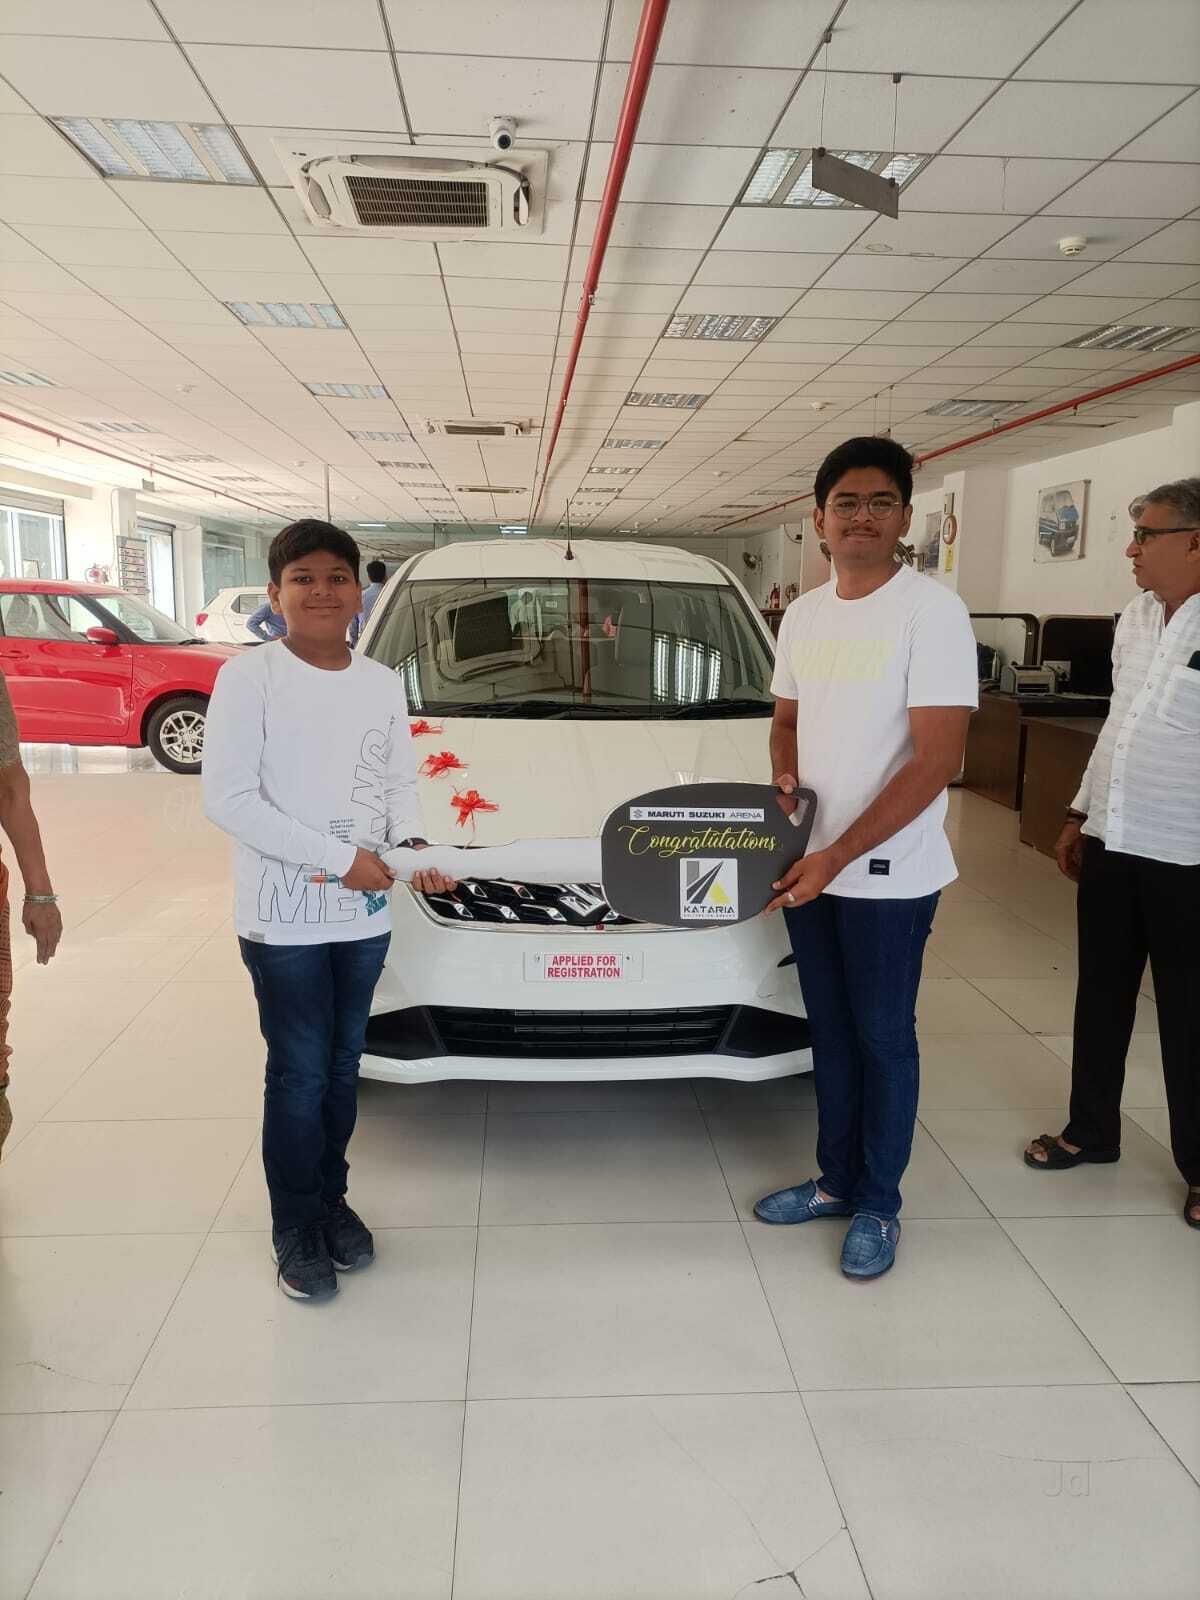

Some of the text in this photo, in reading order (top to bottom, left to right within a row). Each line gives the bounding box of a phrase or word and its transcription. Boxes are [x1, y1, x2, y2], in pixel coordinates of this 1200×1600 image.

[617, 825, 777, 857] Congratulations
[684, 905, 735, 913] KATARIA
[552, 955, 616, 966] APPLIED FOR
[547, 967, 621, 978] REGISTRATION
